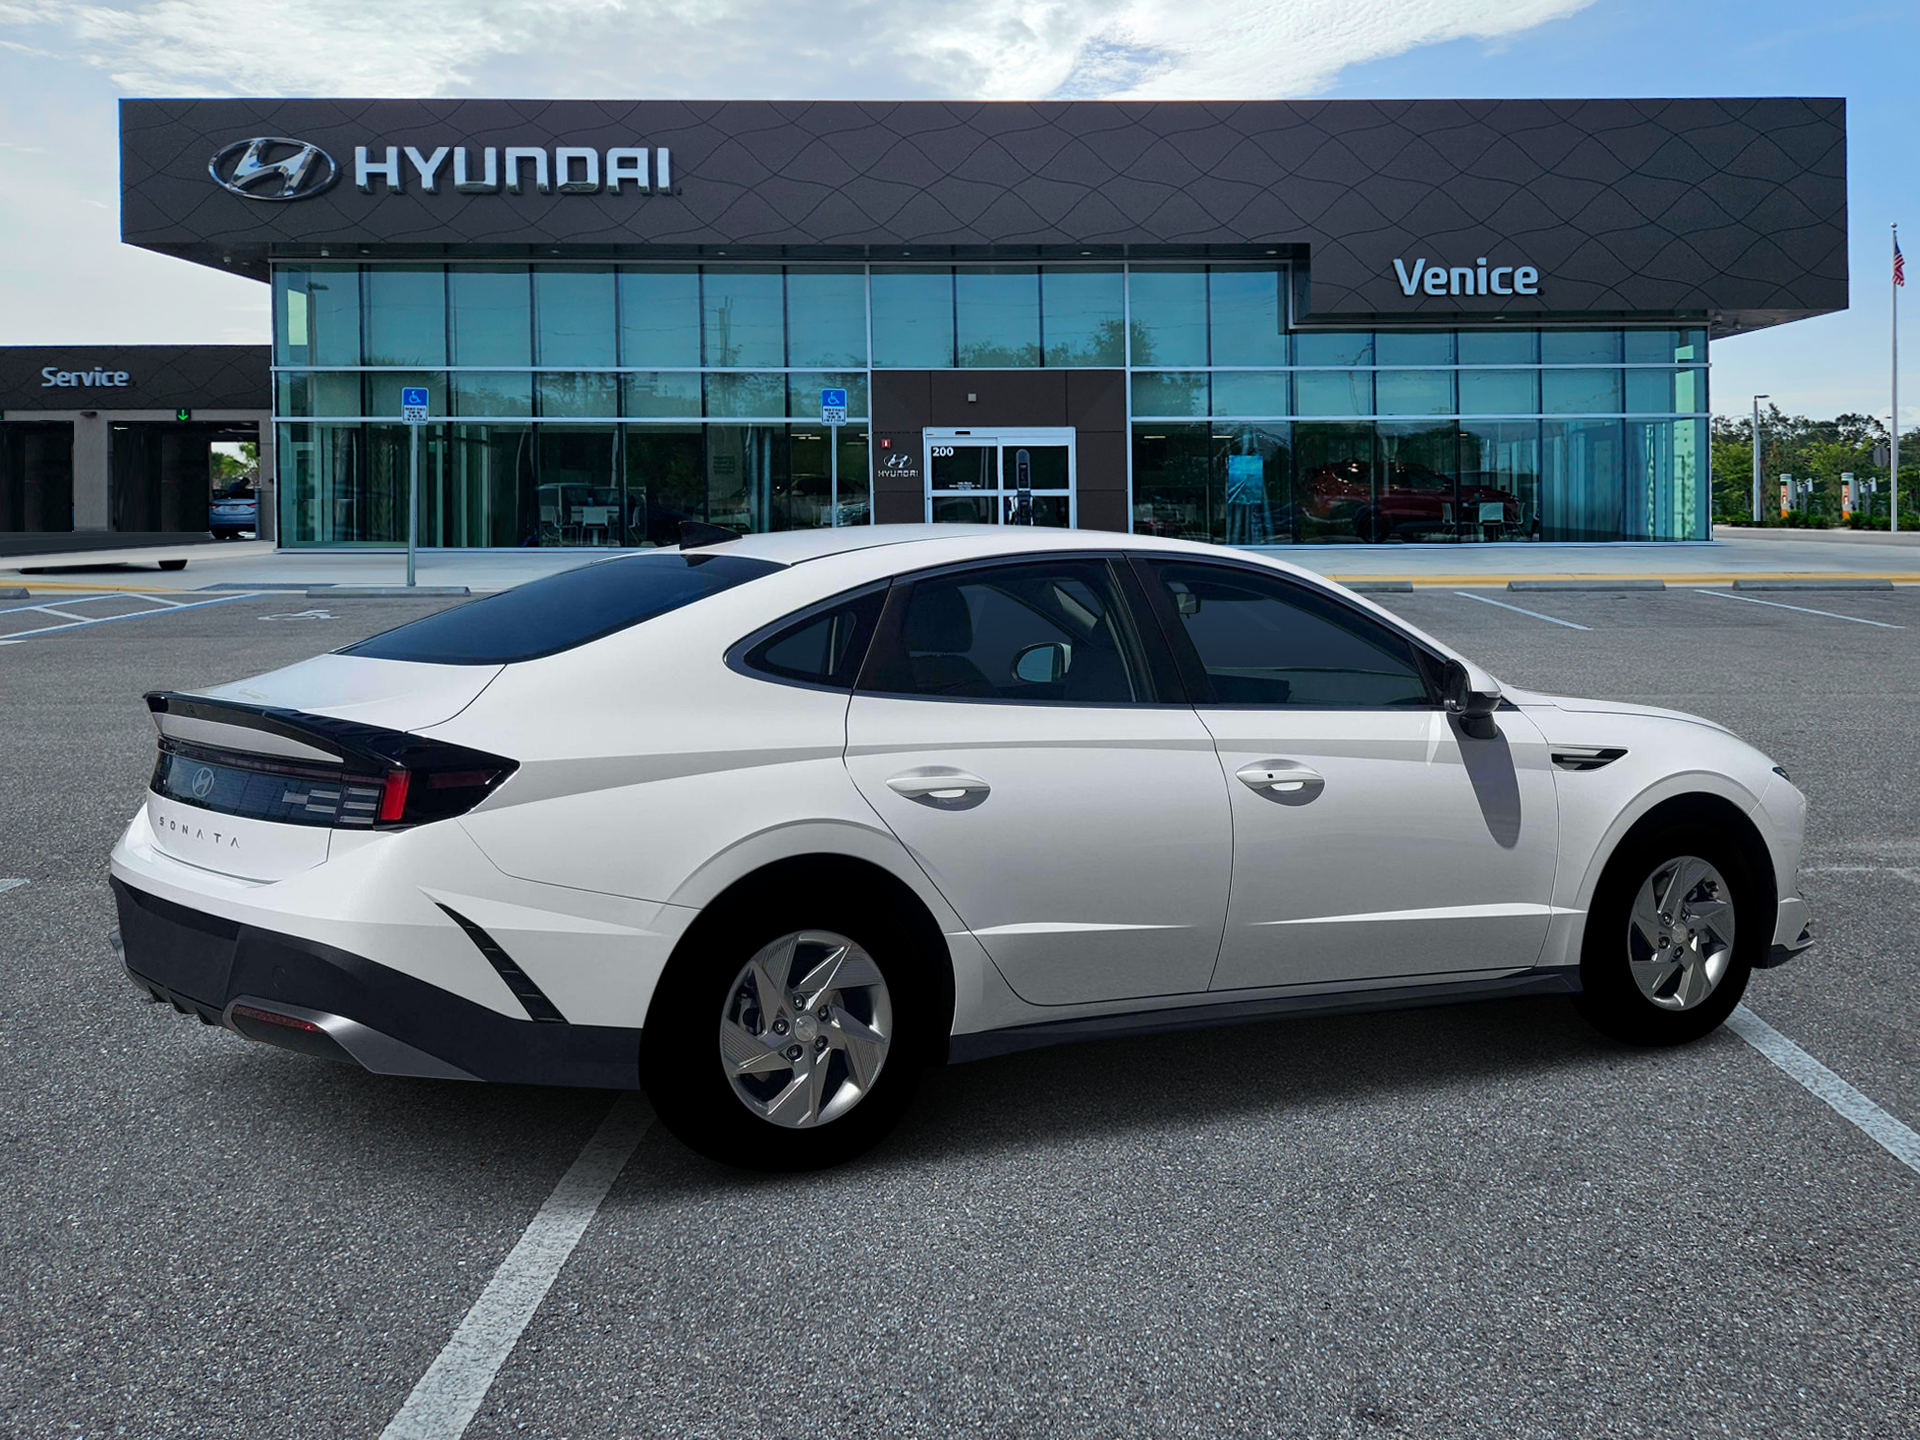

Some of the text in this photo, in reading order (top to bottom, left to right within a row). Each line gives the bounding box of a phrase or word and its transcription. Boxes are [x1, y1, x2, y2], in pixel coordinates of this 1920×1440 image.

[354, 146, 671, 194] HYUNDAI
[1392, 257, 1539, 296] Venice
[41, 366, 130, 387] Service
[932, 446, 954, 457] 200
[877, 469, 919, 478] HYUNDAI
[159, 816, 241, 849] SONATA
